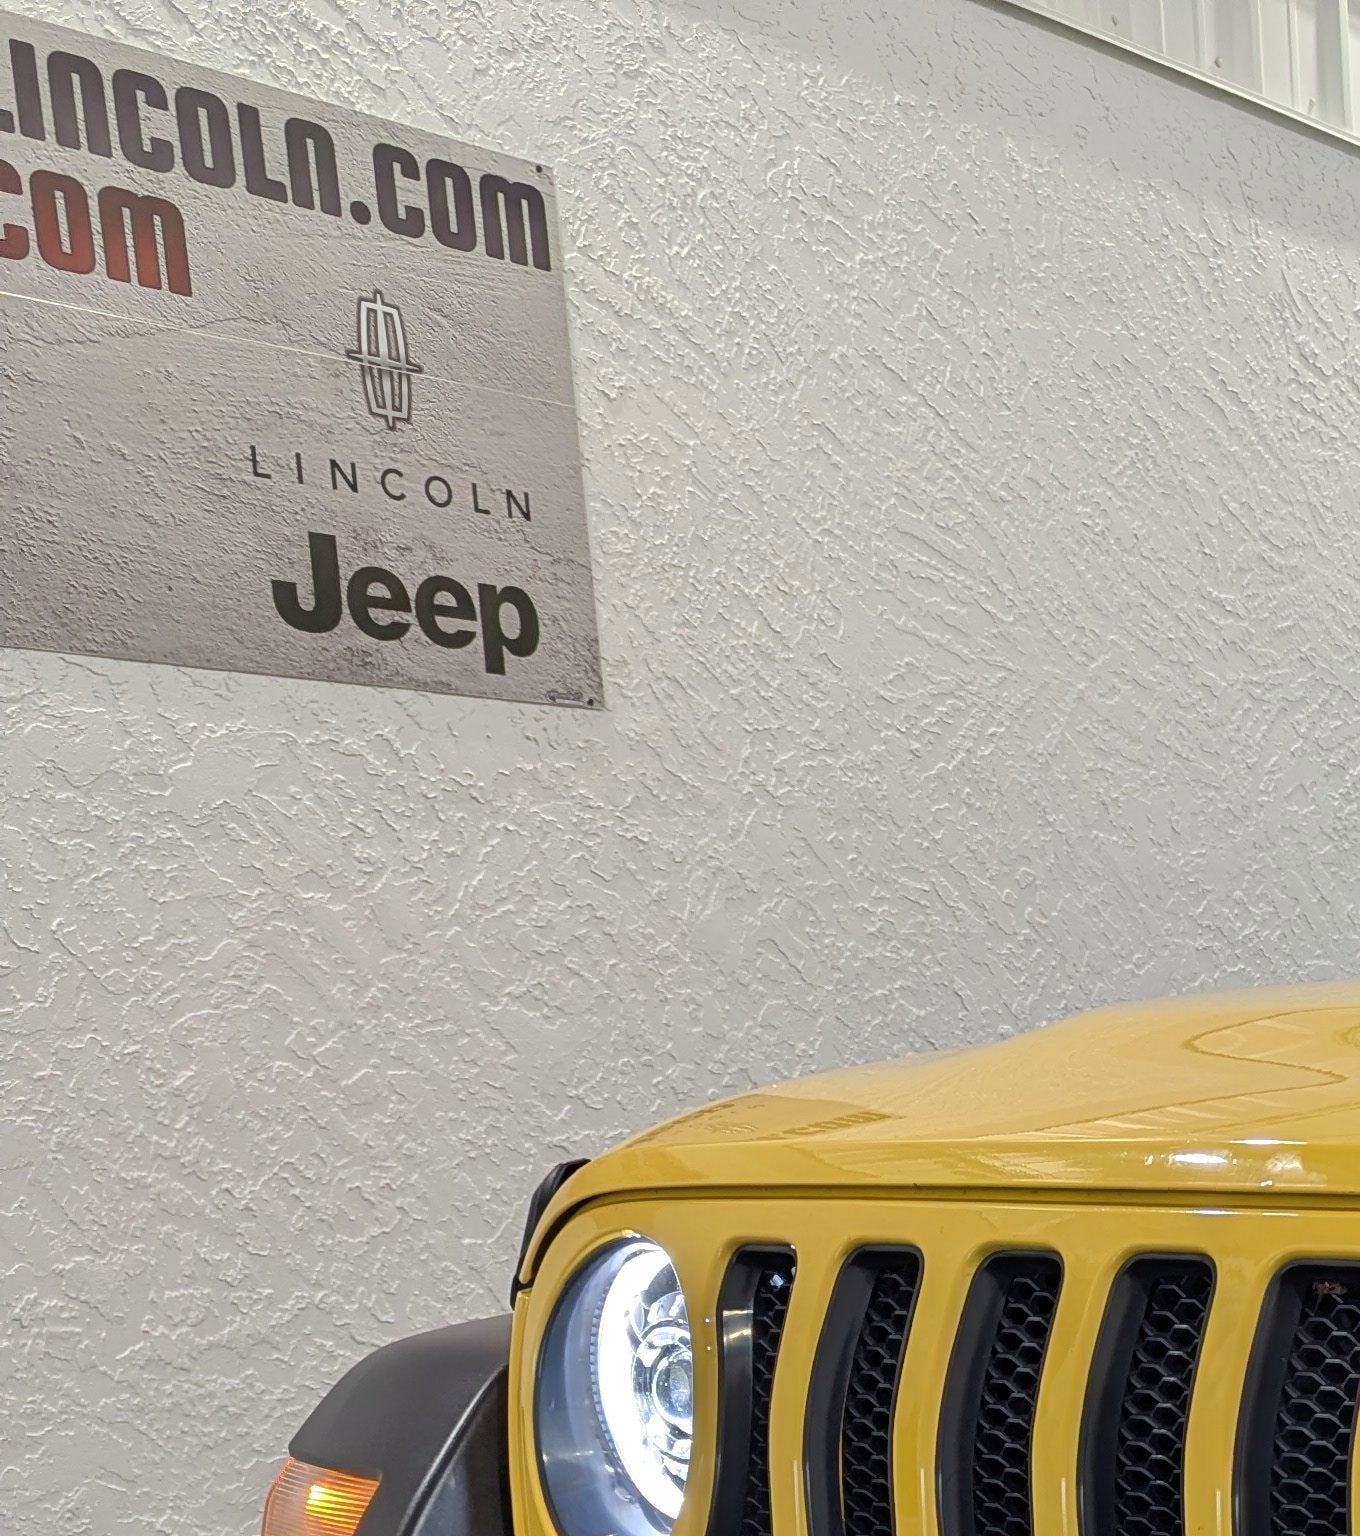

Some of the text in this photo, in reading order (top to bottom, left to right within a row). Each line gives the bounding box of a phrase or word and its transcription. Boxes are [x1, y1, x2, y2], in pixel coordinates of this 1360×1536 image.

[0, 40, 552, 272] INCOLN.COM
[249, 446, 533, 522] LINCOLN
[271, 531, 539, 676] Jeep
